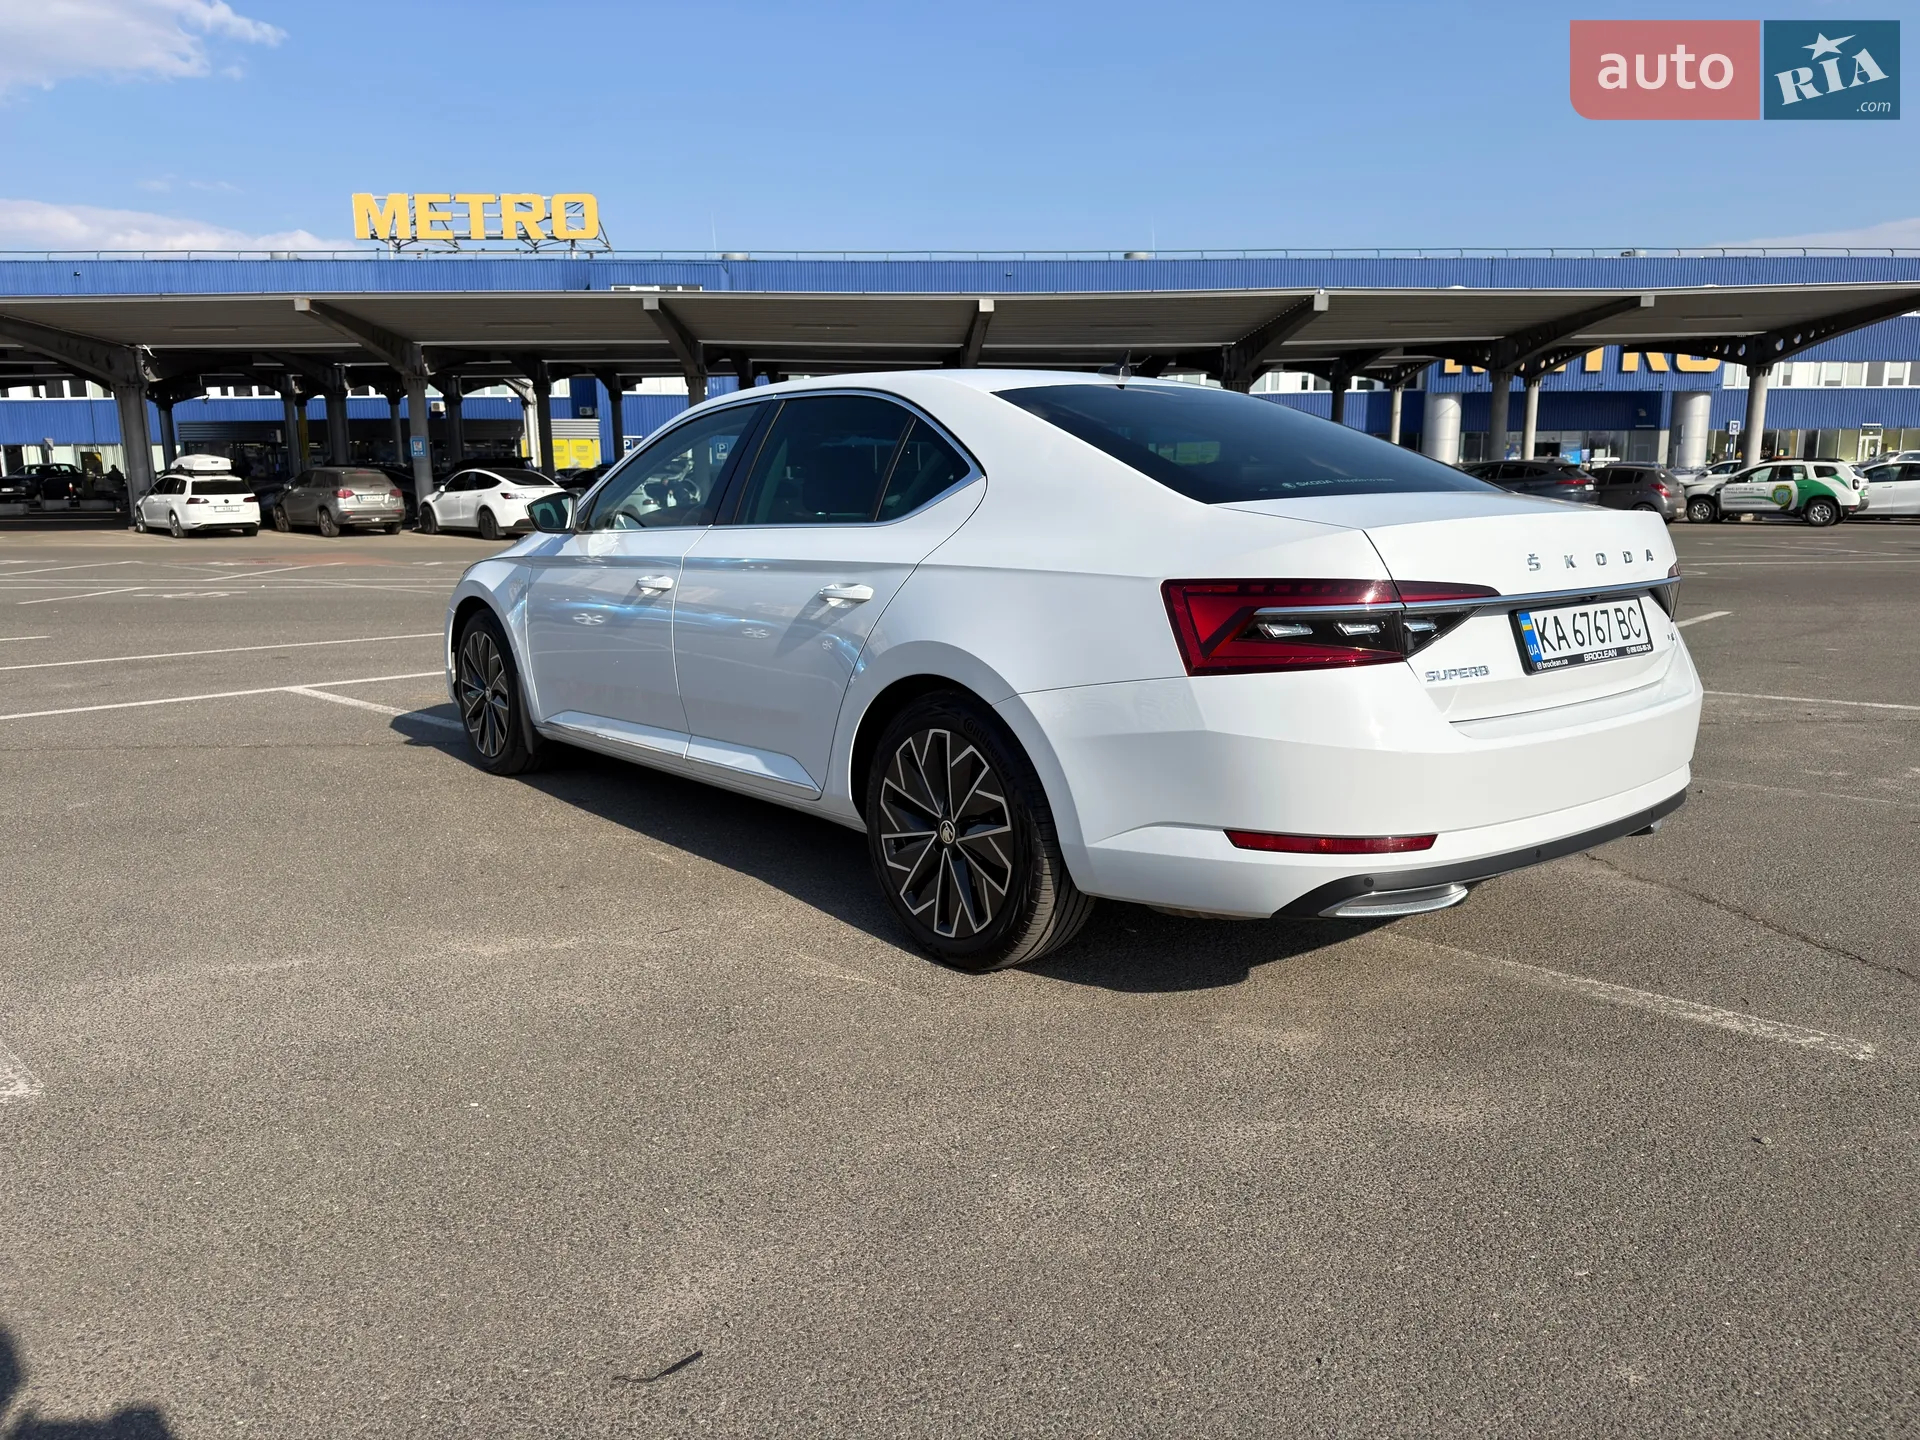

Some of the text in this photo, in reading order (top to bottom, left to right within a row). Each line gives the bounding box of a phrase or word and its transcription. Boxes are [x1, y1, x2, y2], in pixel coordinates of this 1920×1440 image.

[352, 193, 600, 241] METRO
[1527, 549, 1655, 571] ŠKODA
[1534, 606, 1641, 653] KA 6767 BC
[1528, 644, 1540, 656] UA
[1583, 649, 1618, 662] BROCLEAN
[1425, 665, 1490, 683] SUPERB
